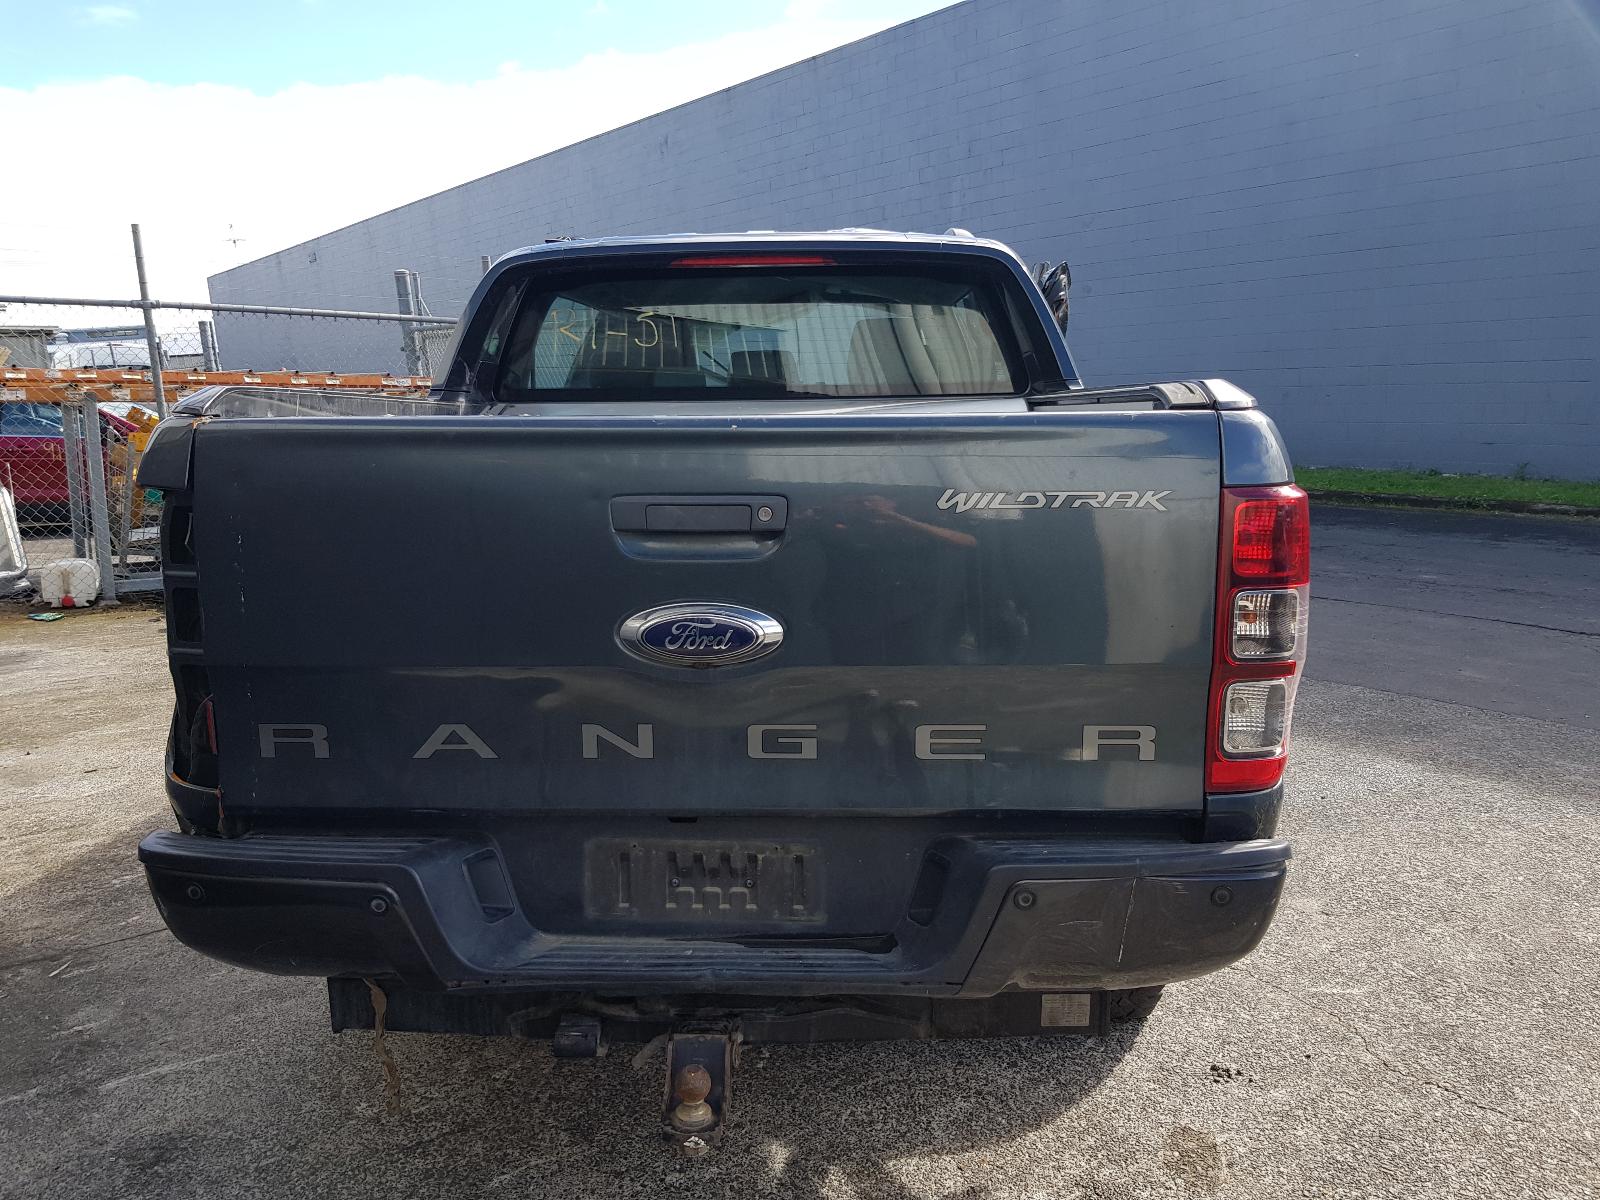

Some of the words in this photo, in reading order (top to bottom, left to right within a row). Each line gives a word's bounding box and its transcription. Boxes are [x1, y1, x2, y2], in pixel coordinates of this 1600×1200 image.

[936, 488, 1173, 514] WILDTRAK
[664, 621, 734, 650] Ford
[258, 723, 1157, 761] RANGER
